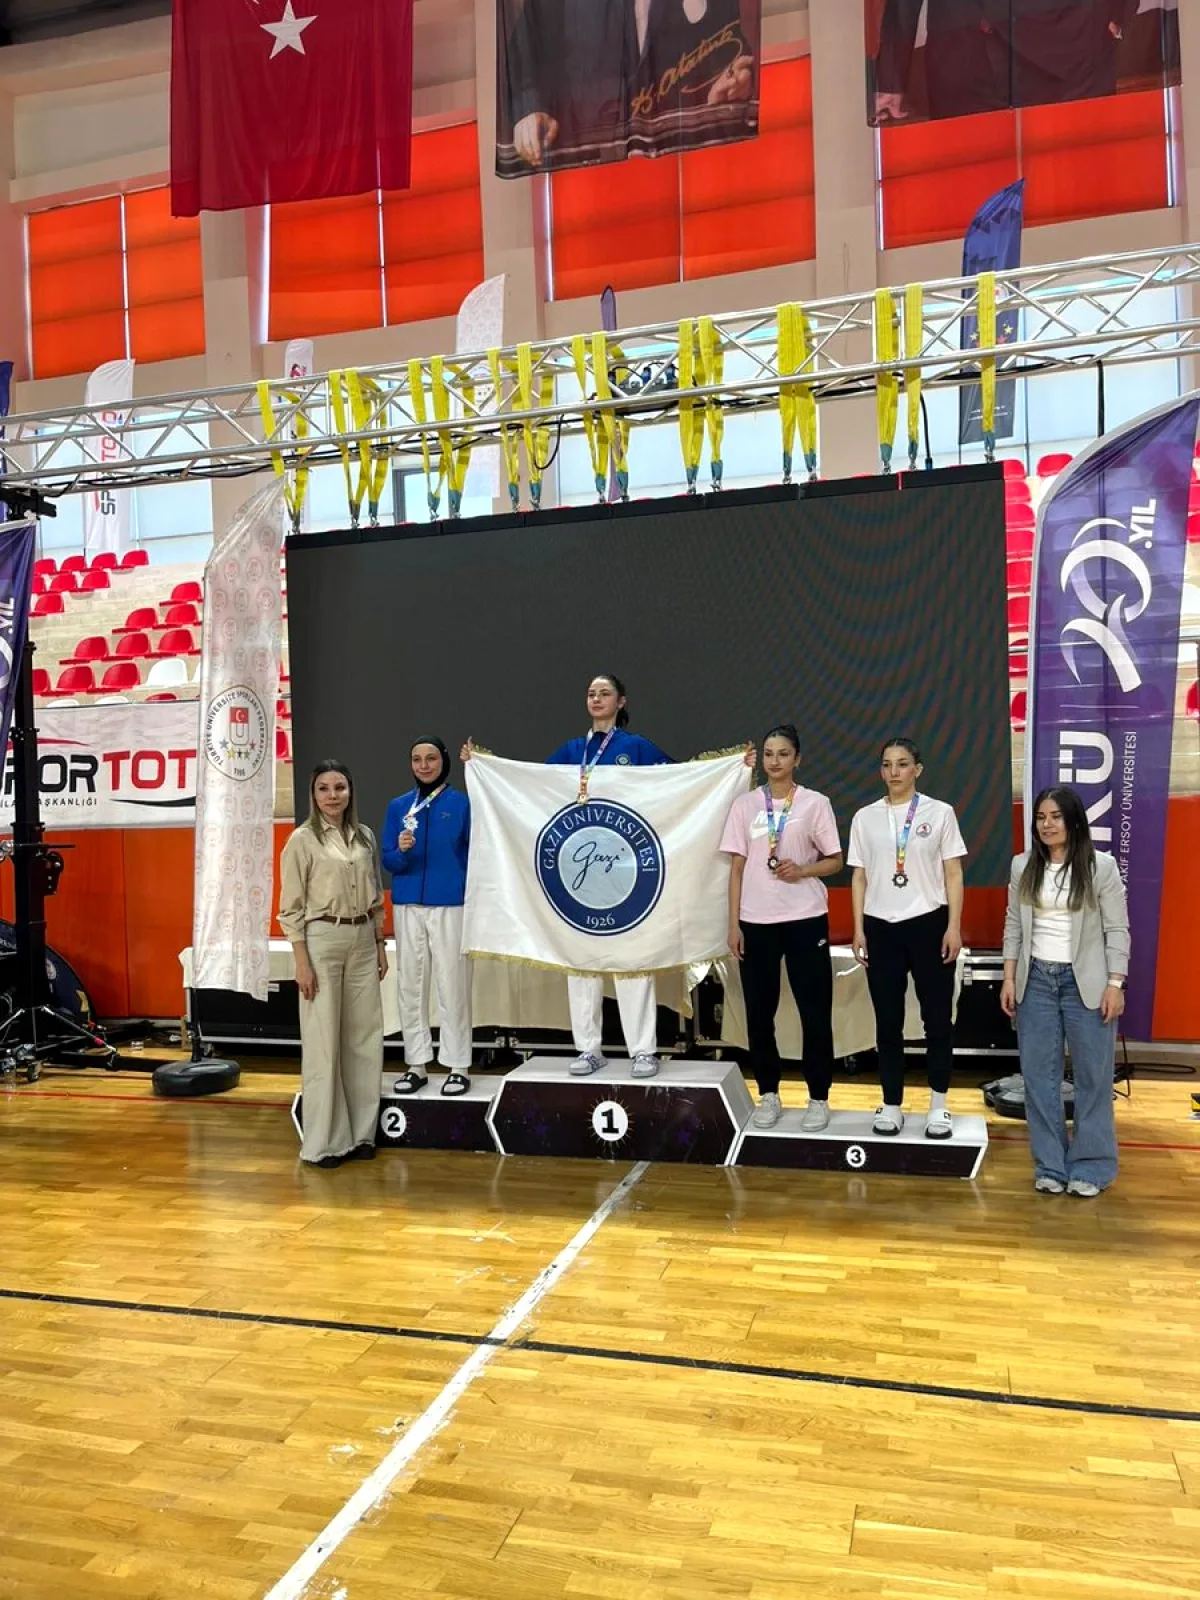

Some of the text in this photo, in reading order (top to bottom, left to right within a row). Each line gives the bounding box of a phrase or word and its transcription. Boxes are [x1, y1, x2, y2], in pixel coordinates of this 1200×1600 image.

[1119, 731, 1137, 811] ÜNİVERSİTESİ
[562, 806, 658, 872] ÜNİVERSİTESİ
[1119, 814, 1132, 853] ERSOY
[586, 912, 616, 929] 1926
[387, 1112, 401, 1132] 2
[601, 1108, 620, 1134] 1
[849, 1148, 862, 1164] 3
